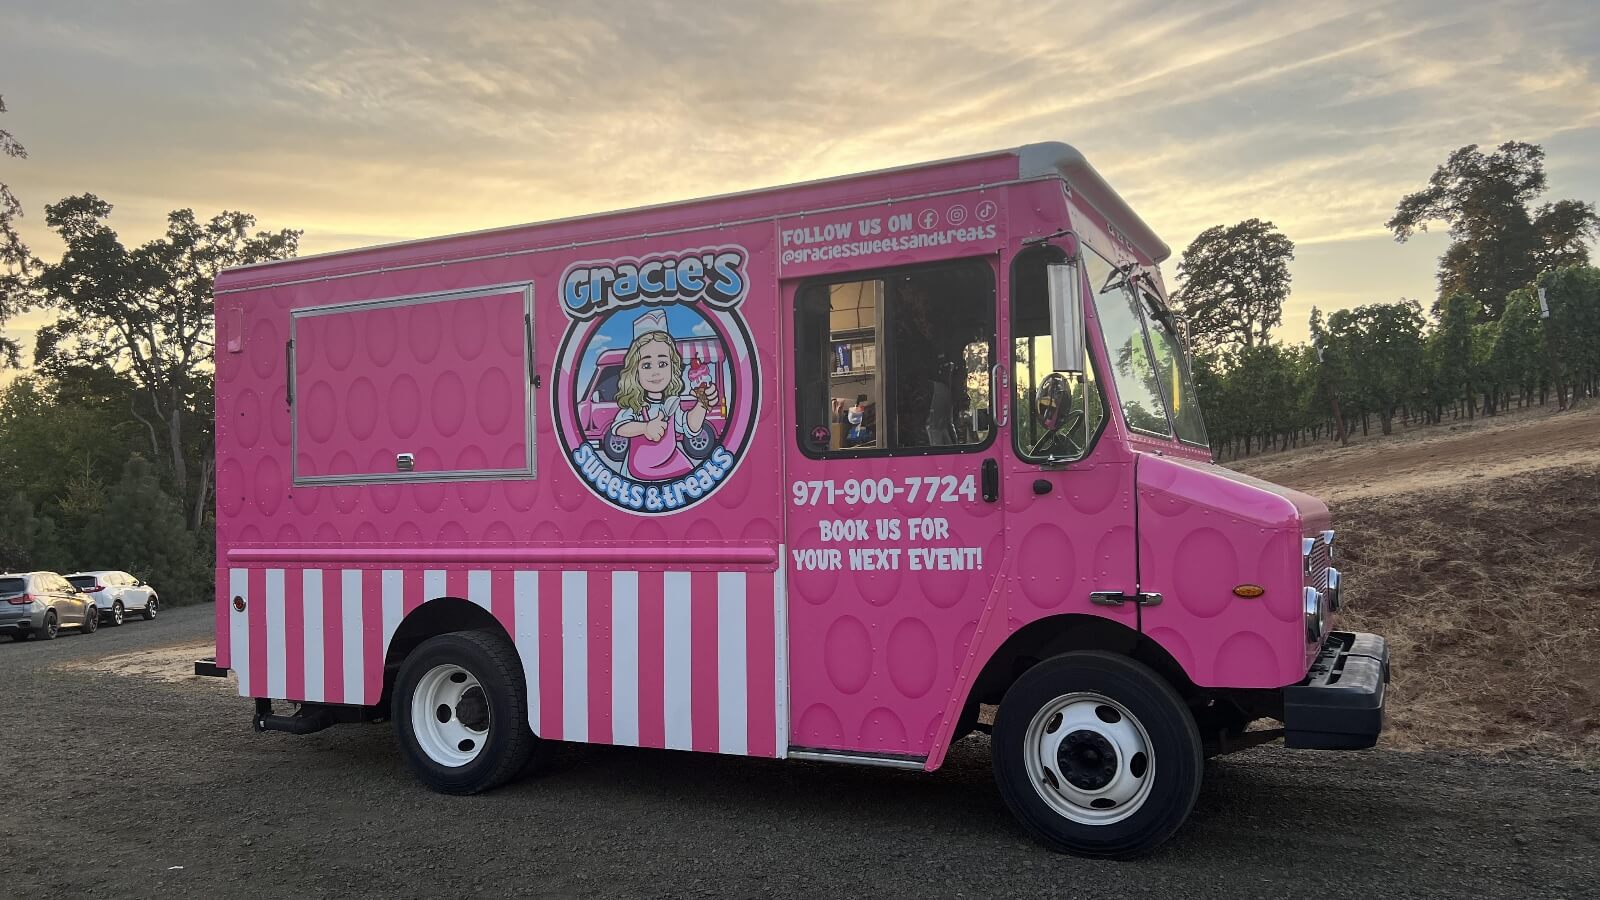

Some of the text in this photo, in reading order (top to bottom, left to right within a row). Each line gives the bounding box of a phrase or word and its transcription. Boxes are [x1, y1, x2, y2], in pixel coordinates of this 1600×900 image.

[782, 213, 913, 246] FOLLOW US ON
[782, 224, 996, 265] @graciessweetsandtreats
[792, 474, 977, 506] 971-900-7724
[819, 517, 950, 542] BOOK US FOR
[792, 546, 983, 571] YOUR NEXT EVENT!
